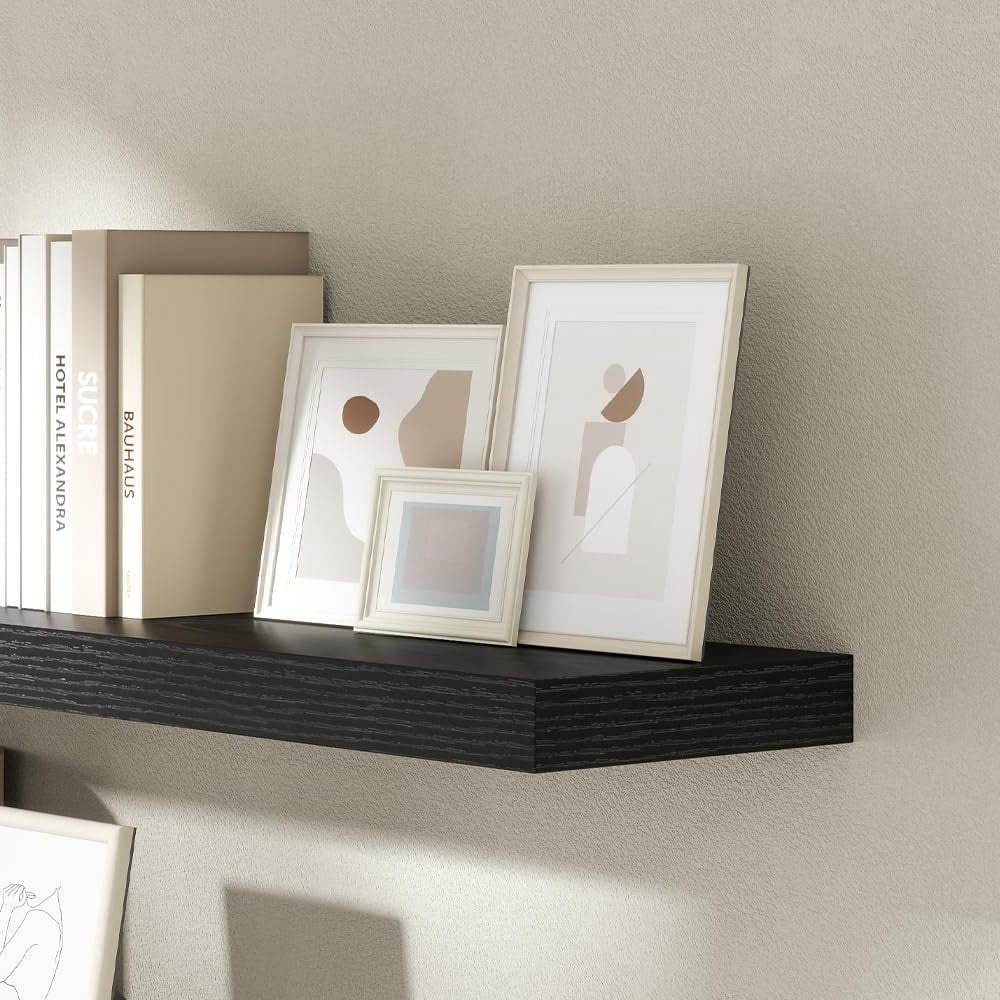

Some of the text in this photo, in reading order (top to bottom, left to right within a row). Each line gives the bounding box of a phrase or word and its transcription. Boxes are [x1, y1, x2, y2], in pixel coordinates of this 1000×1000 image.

[55, 355, 66, 532] HOTEL ALEXANDRA
[77, 371, 98, 457] SUCRE
[123, 411, 135, 499] BAUHAUS
